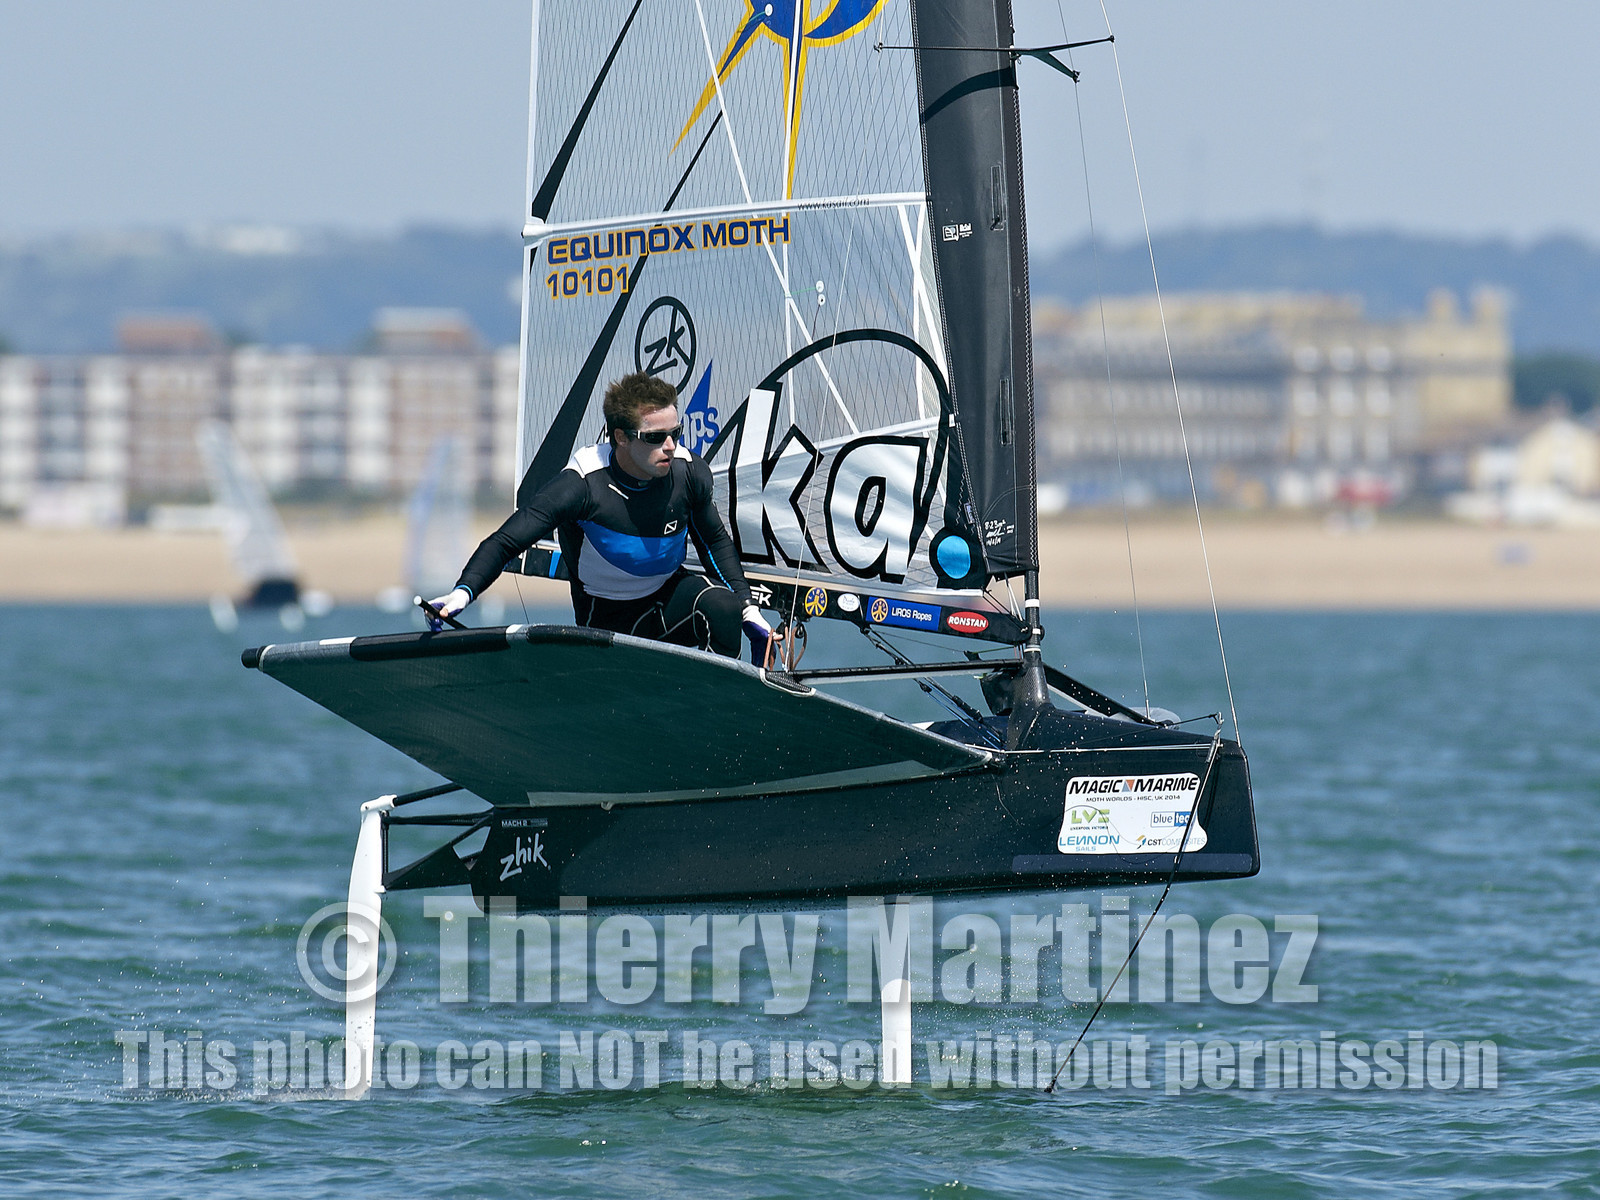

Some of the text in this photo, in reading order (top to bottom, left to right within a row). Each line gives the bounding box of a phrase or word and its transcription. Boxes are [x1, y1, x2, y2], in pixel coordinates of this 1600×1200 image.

[548, 215, 790, 265] EQUINOX MOTH
[546, 263, 629, 299] 10101
[891, 607, 932, 622] LIROS Ropes
[948, 616, 986, 628] RONSTAN
[1069, 777, 1199, 794] MAGIC MARINE
[1153, 814, 1172, 824] blue
[1059, 835, 1120, 846] LENNON
